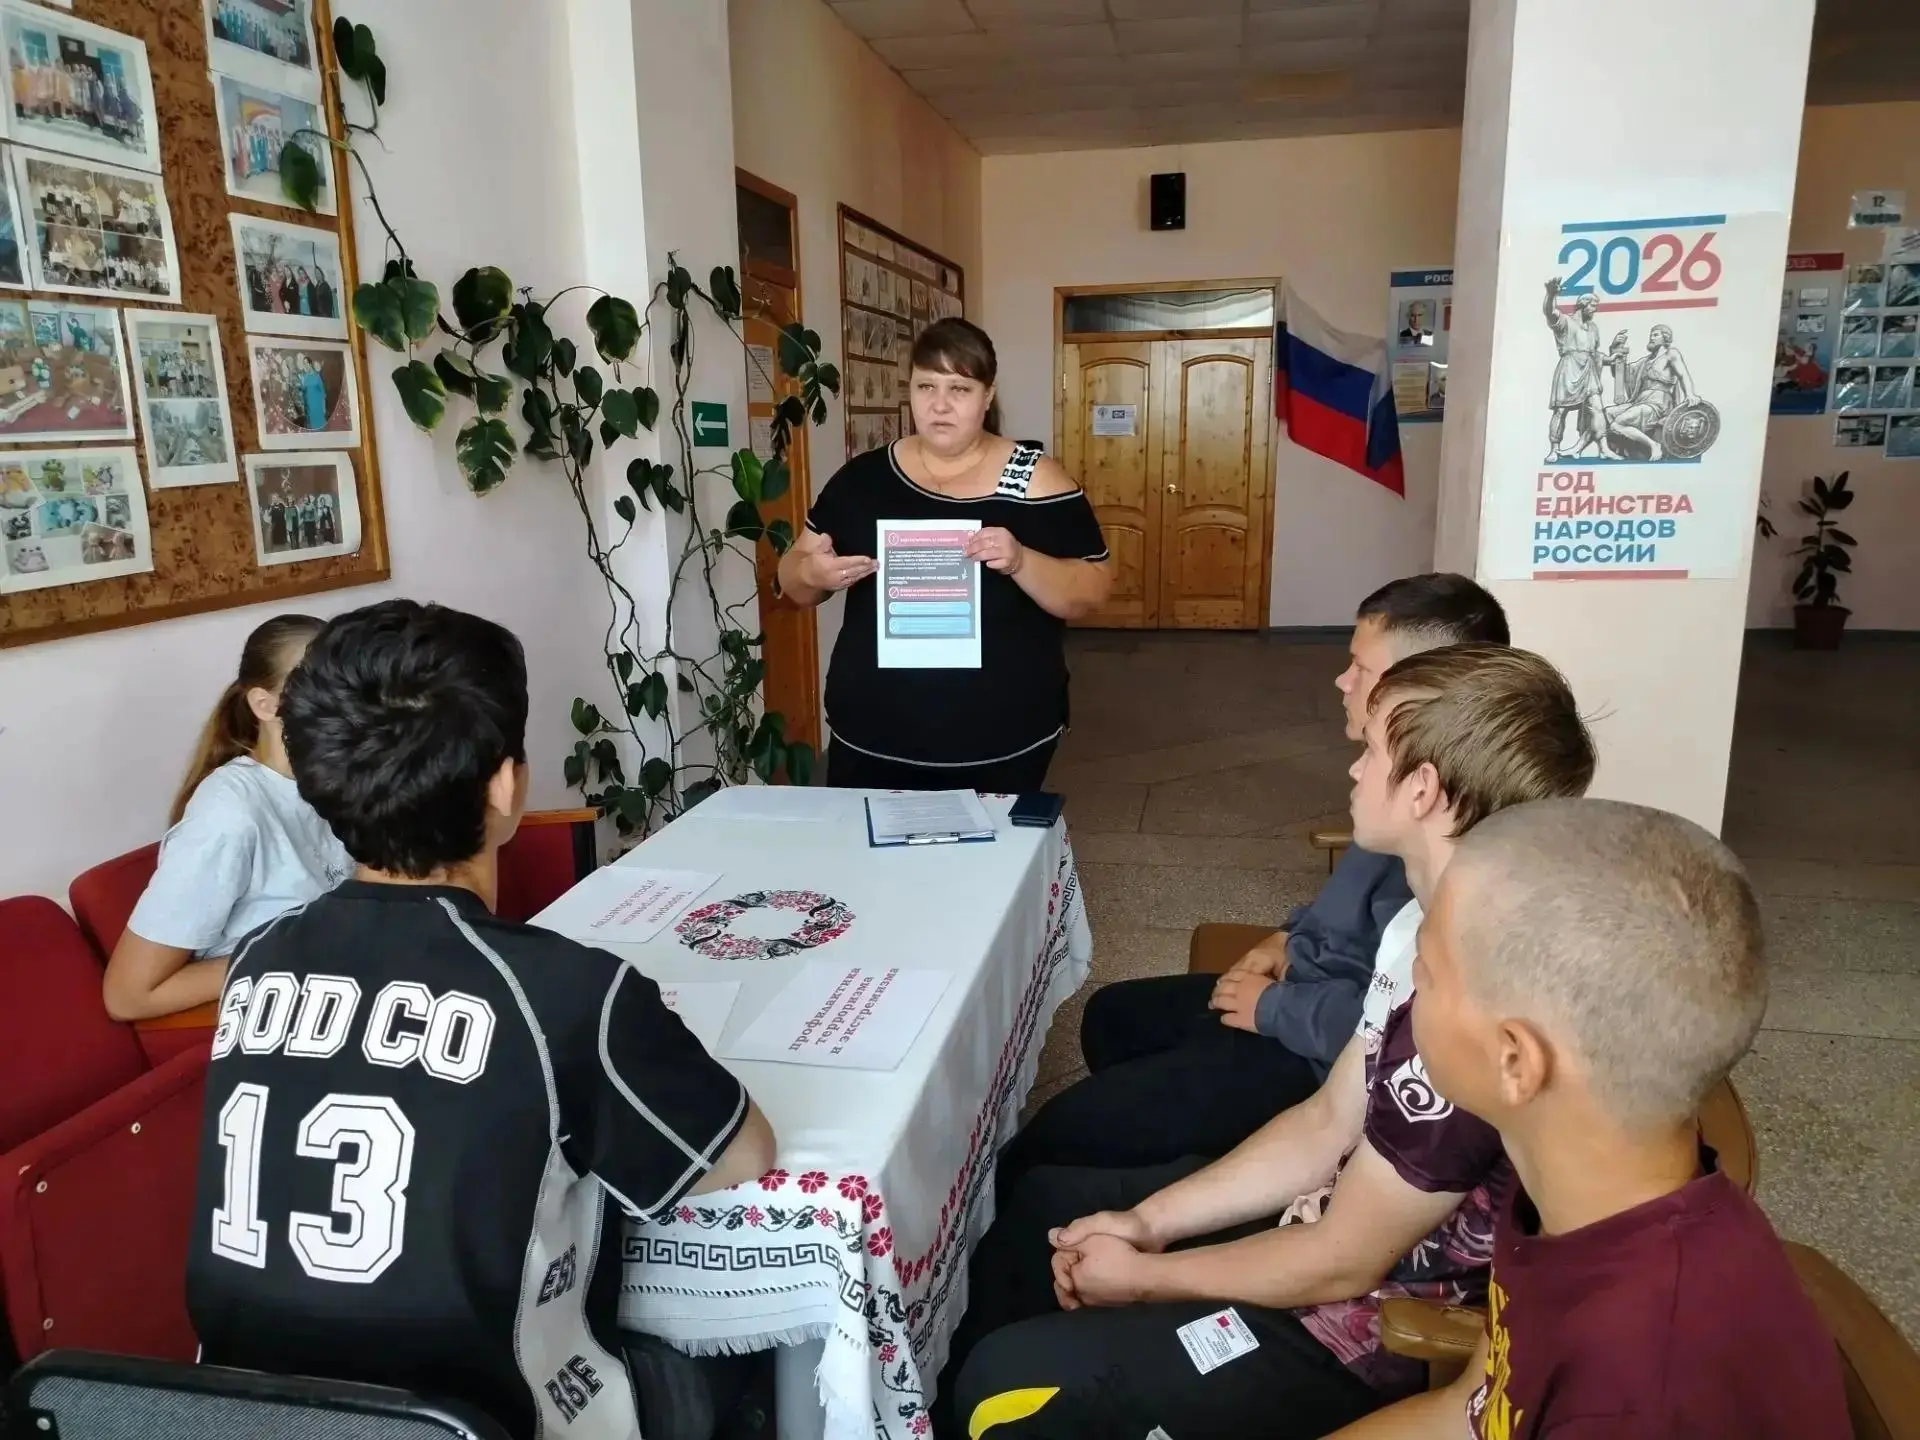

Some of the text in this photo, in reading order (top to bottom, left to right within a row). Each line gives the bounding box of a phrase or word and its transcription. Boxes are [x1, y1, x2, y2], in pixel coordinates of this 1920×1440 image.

[1558, 232, 1722, 297] 2026
[1535, 495, 1693, 518] ЕДИНСТВА
[1537, 472, 1595, 493] ГОД
[1533, 544, 1655, 563] РОССИИ
[1534, 519, 1676, 541] НАРОДОВ
[211, 972, 496, 1084] SOD CO
[788, 968, 861, 1051] профилактика
[815, 976, 874, 1045] терроризма
[830, 968, 899, 1054] и экстремизма
[211, 1082, 416, 1283] 13
[544, 1354, 604, 1425] RSE
